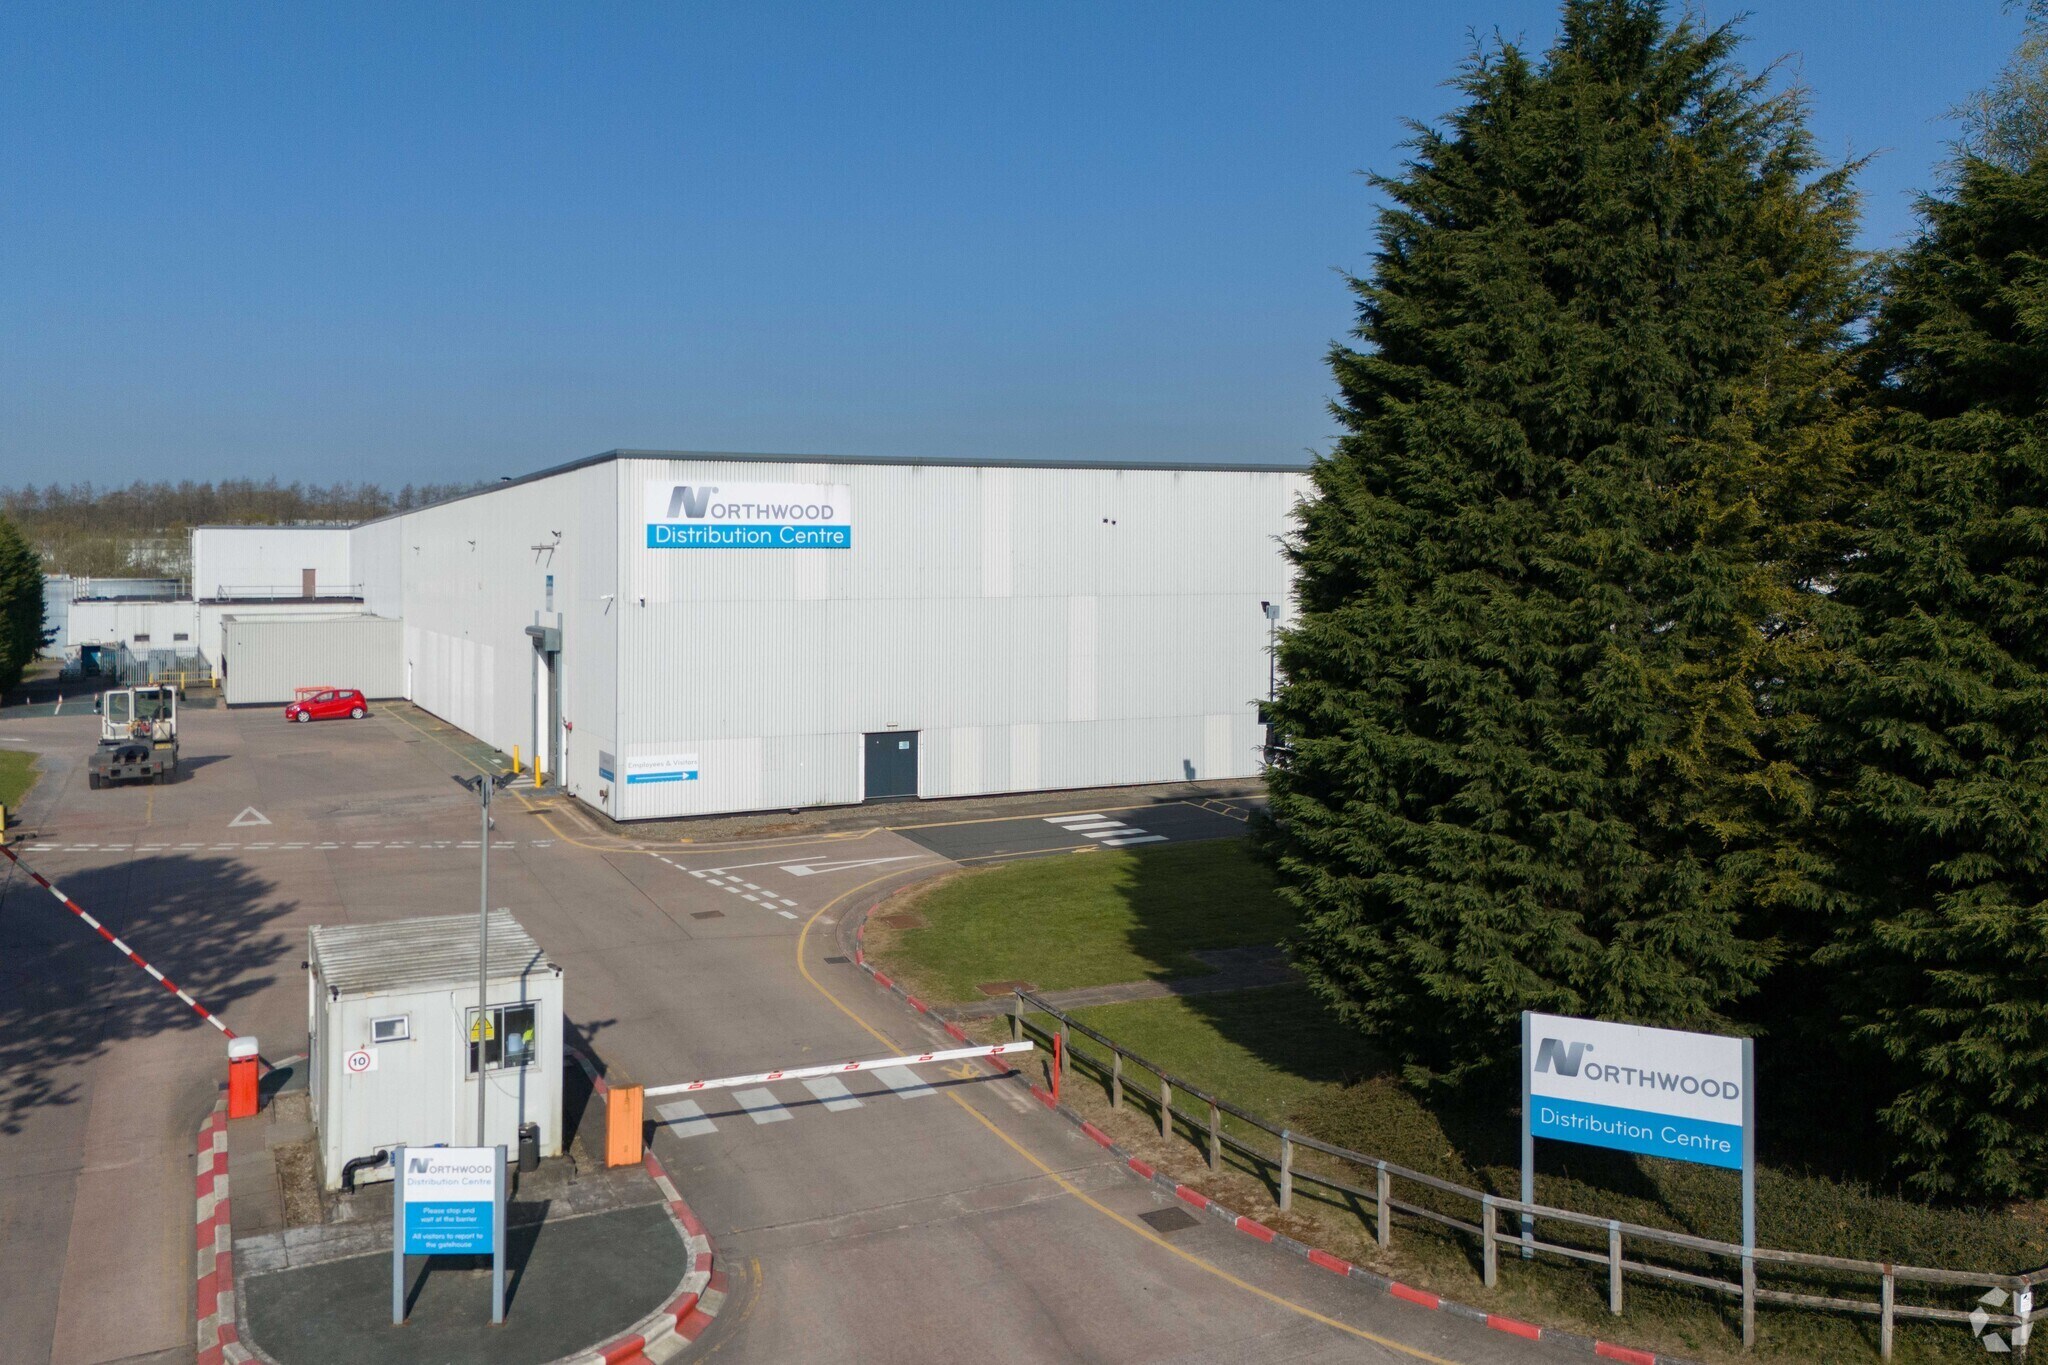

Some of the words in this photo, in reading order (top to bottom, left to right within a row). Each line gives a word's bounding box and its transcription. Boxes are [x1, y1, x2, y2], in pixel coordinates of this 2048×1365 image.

[666, 486, 834, 520] NORTHWOOD
[655, 525, 772, 544] Distribution
[779, 526, 844, 544] Centre
[628, 761, 664, 769] Employees
[353, 1057, 366, 1066] 10
[1534, 1037, 1739, 1100] NORTHWOOD
[1541, 1107, 1653, 1140] Distribution
[1661, 1126, 1731, 1153] Centre
[408, 1158, 492, 1174] NORTHWOOD
[407, 1178, 459, 1186] Distribution
[461, 1178, 491, 1186] Centre
[446, 1207, 461, 1215] stop
[455, 1233, 475, 1241] report
